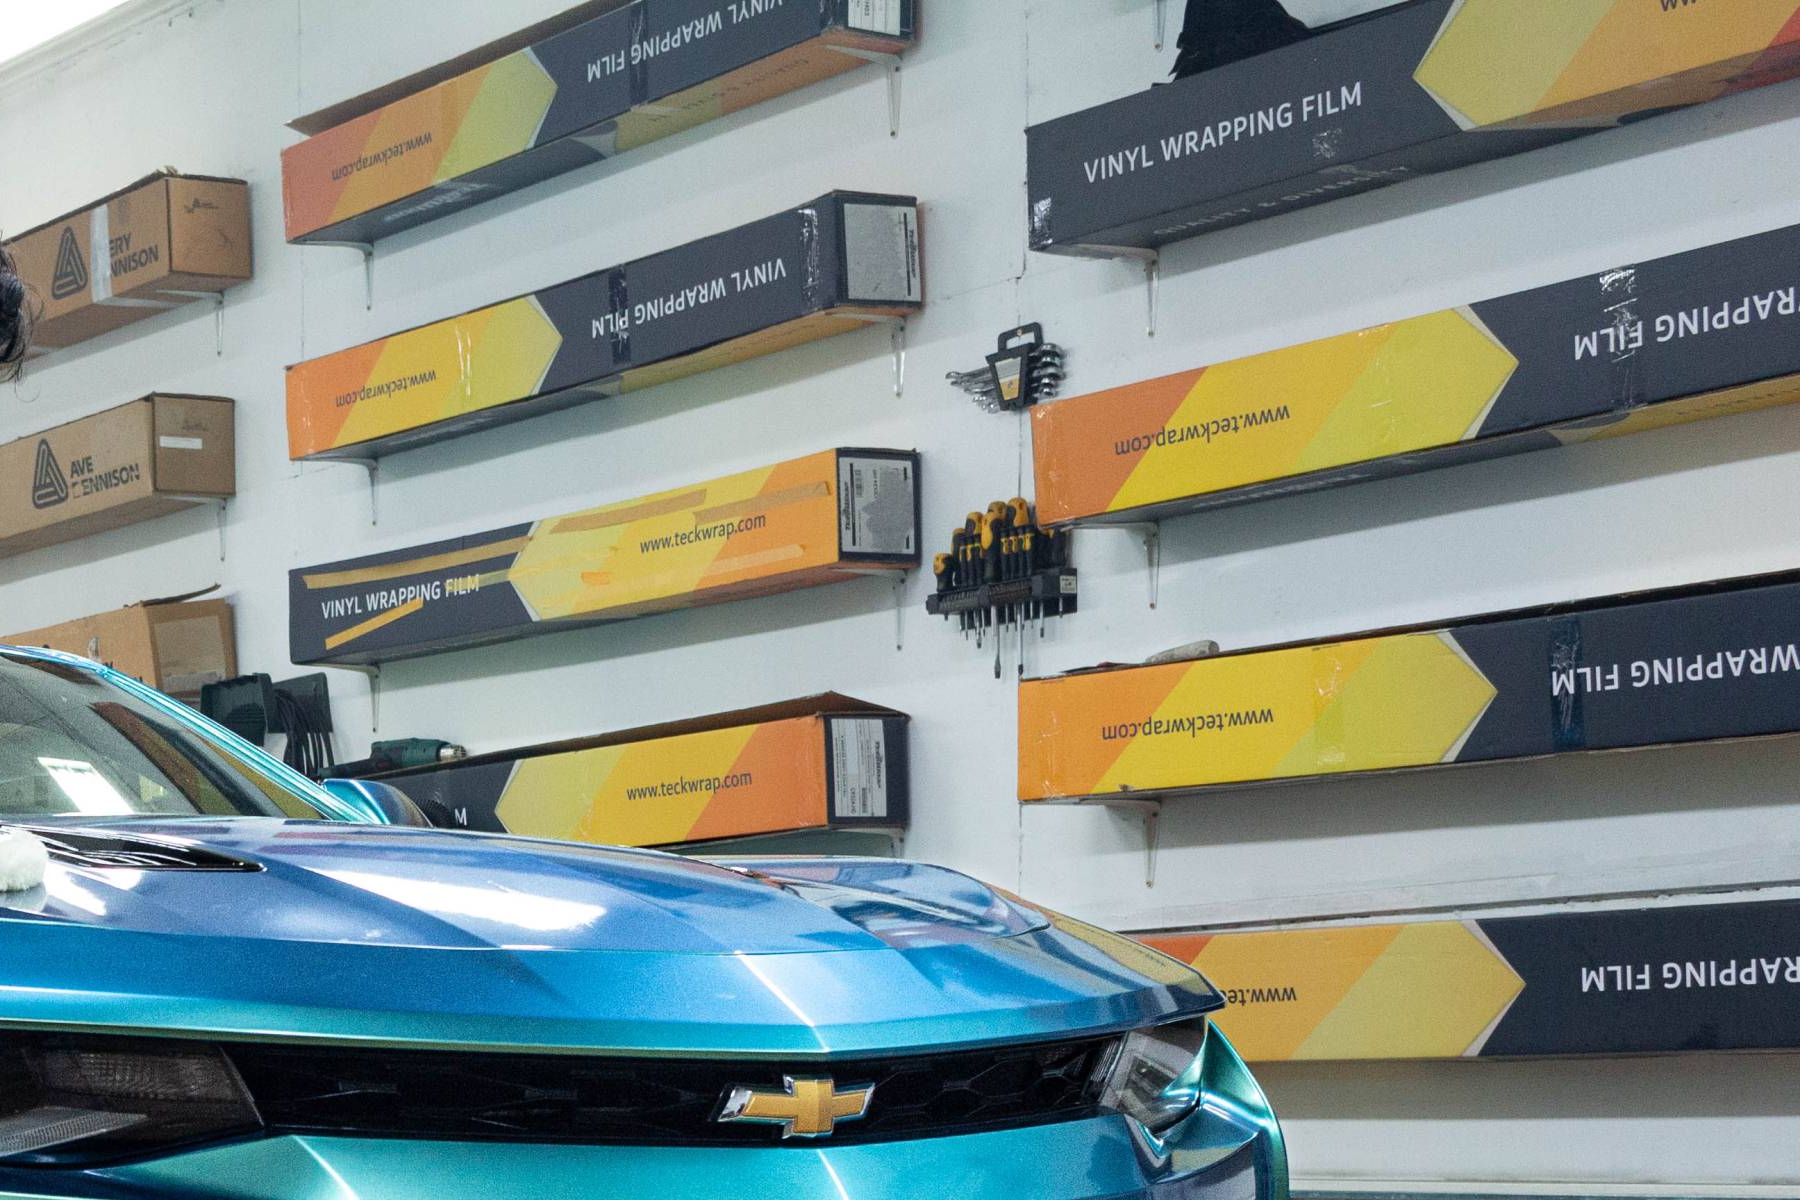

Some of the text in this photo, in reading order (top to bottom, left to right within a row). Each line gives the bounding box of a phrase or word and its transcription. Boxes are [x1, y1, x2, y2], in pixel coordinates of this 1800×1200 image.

[630, 9, 722, 64] WRAPPING
[586, 52, 626, 82] FILM
[1084, 81, 1363, 184] VINYL WRAPPING FILM
[331, 129, 433, 182] www.teckwrap.com
[108, 232, 131, 258] ERY
[110, 244, 159, 277] NNISON
[591, 258, 786, 339] VINYL WRAPPING FILM
[1574, 286, 1800, 361] RAPPING FILM
[335, 369, 437, 408] www.teckwrap.com
[1113, 404, 1291, 457] www.teckwrap.com
[70, 456, 93, 478] AVE
[639, 513, 767, 555] www.teckwrap.com
[321, 573, 480, 619] VINYL WRAPPING FILM
[1552, 643, 1800, 696] WRAPPING FILM
[1101, 707, 1274, 743] www.teckwrap.com
[626, 769, 753, 801] www.teckwrap.com
[1581, 956, 1800, 993] RAPPING FILM
